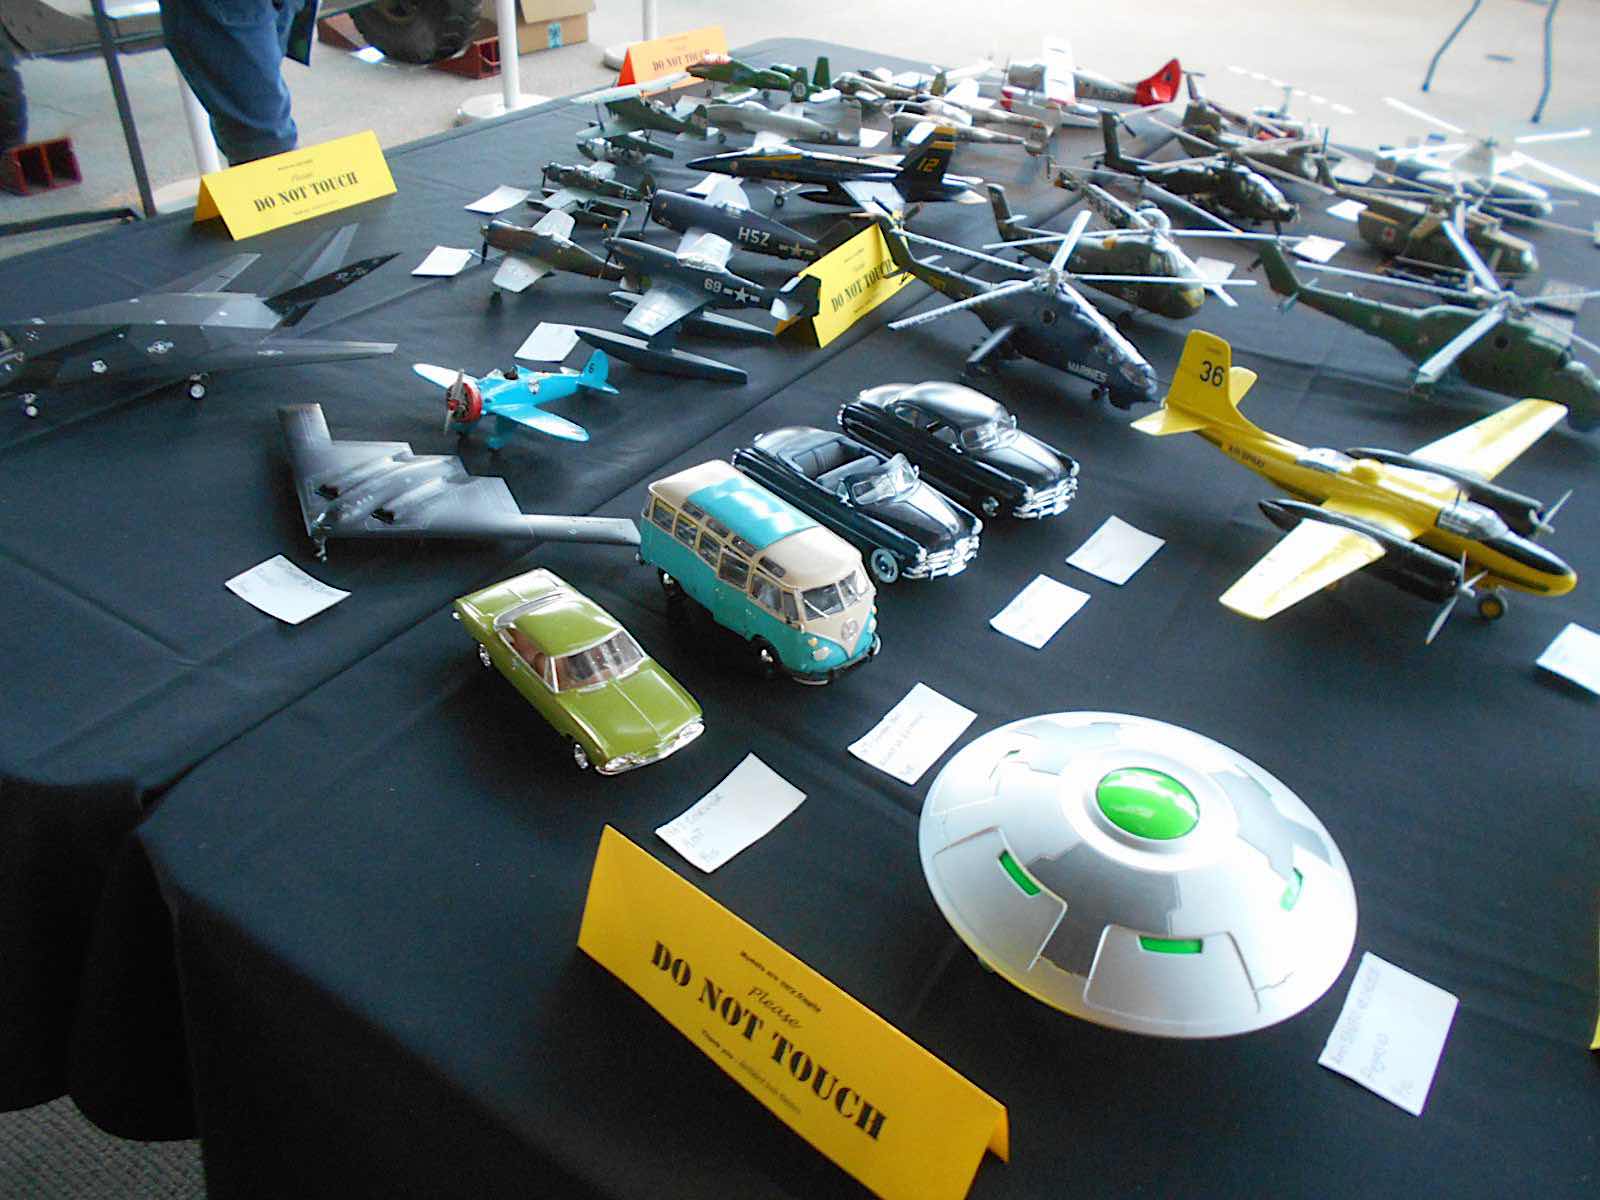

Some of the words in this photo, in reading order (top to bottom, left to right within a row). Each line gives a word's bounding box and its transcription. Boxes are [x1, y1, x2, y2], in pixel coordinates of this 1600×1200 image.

[917, 156, 941, 172] 12
[253, 195, 276, 212] DO
[278, 184, 308, 205] NOT
[310, 171, 359, 196] TOUCH
[831, 293, 845, 313] DO
[844, 278, 863, 300] NOT
[1200, 360, 1225, 387] 36
[747, 985, 804, 1029] Please
[651, 939, 692, 987] DO
[698, 976, 764, 1041] NOT
[771, 1032, 887, 1141] TOUCH
